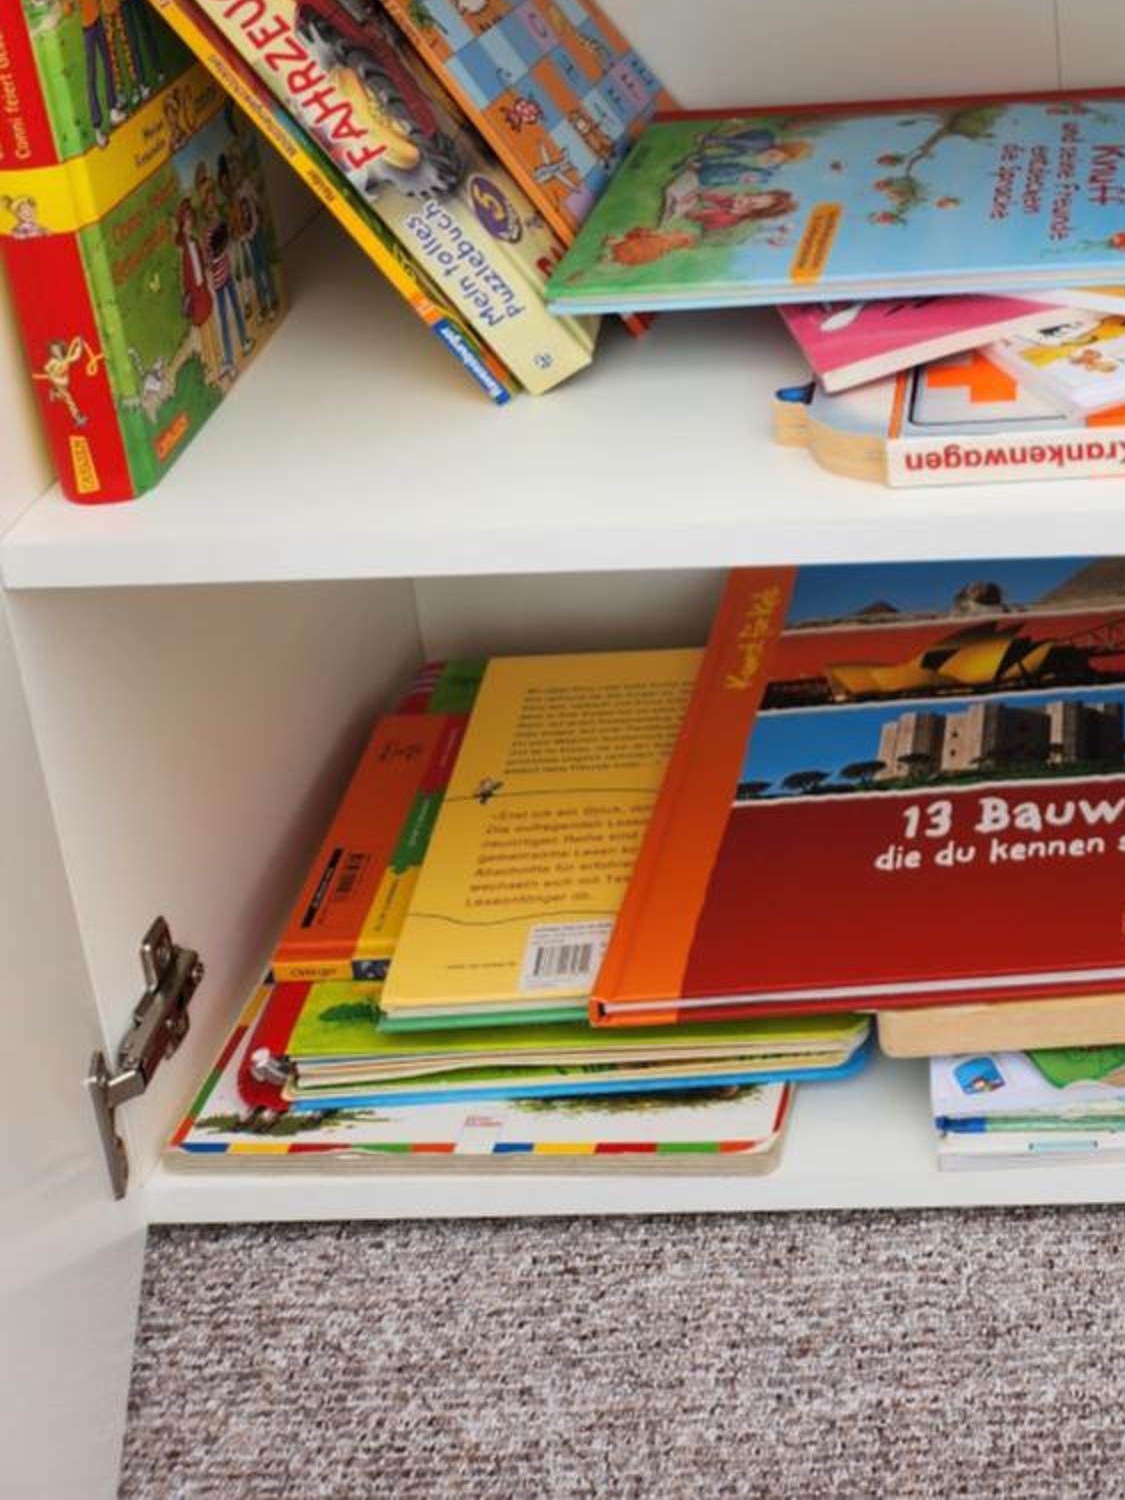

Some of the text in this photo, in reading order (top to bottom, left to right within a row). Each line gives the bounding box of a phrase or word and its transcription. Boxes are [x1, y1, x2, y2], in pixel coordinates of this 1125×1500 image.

[406, 212, 505, 328] Mein tolles
[902, 800, 953, 840] 13
[874, 843, 921, 872] die
[935, 841, 976, 867] du
[989, 832, 1106, 863] kennen
